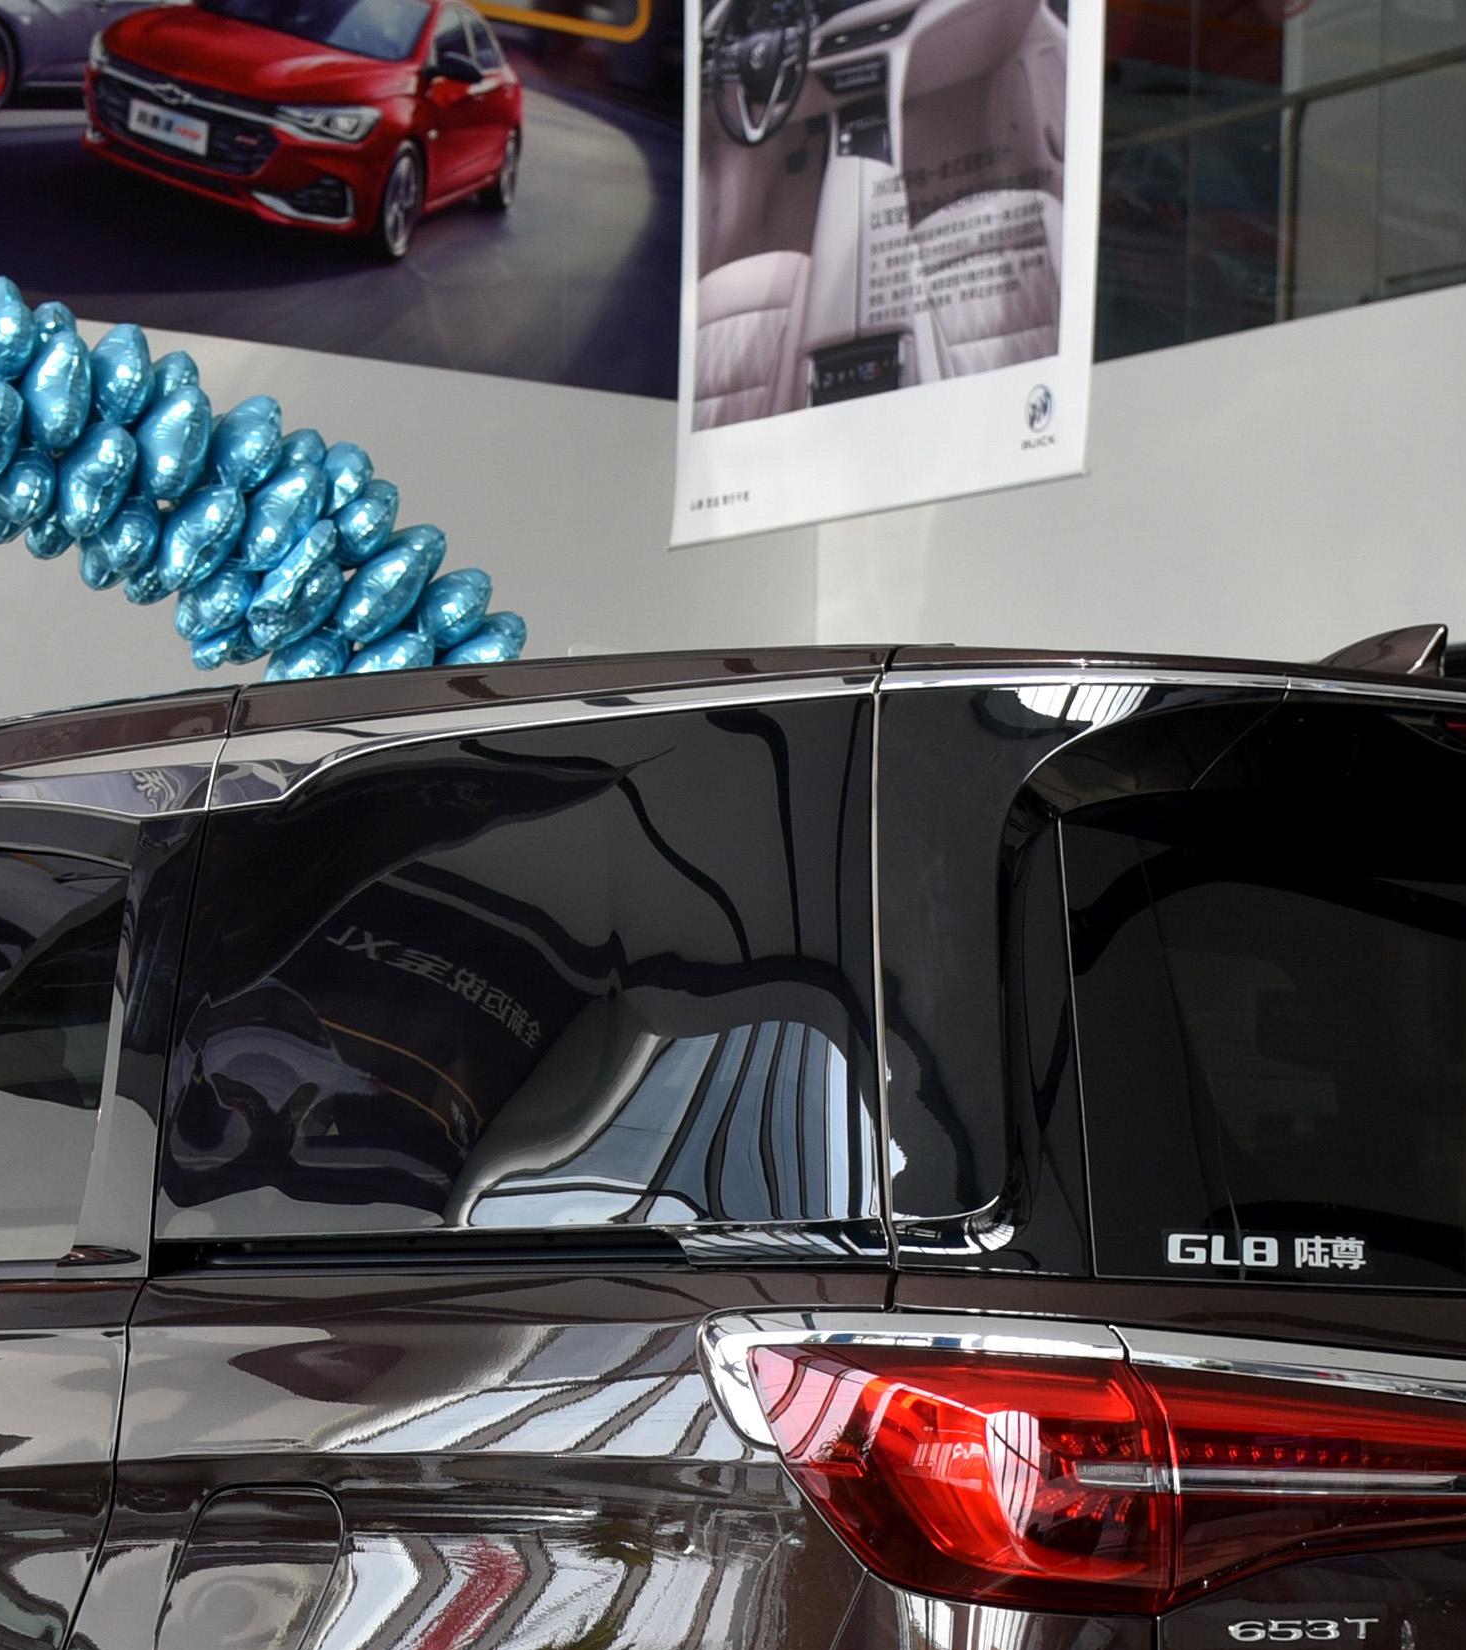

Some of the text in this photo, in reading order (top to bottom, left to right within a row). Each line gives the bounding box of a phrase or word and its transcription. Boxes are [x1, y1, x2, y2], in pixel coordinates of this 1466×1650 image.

[1166, 1234, 1366, 1271] GL8 陆尊
[1228, 1616, 1379, 1643] 653T
